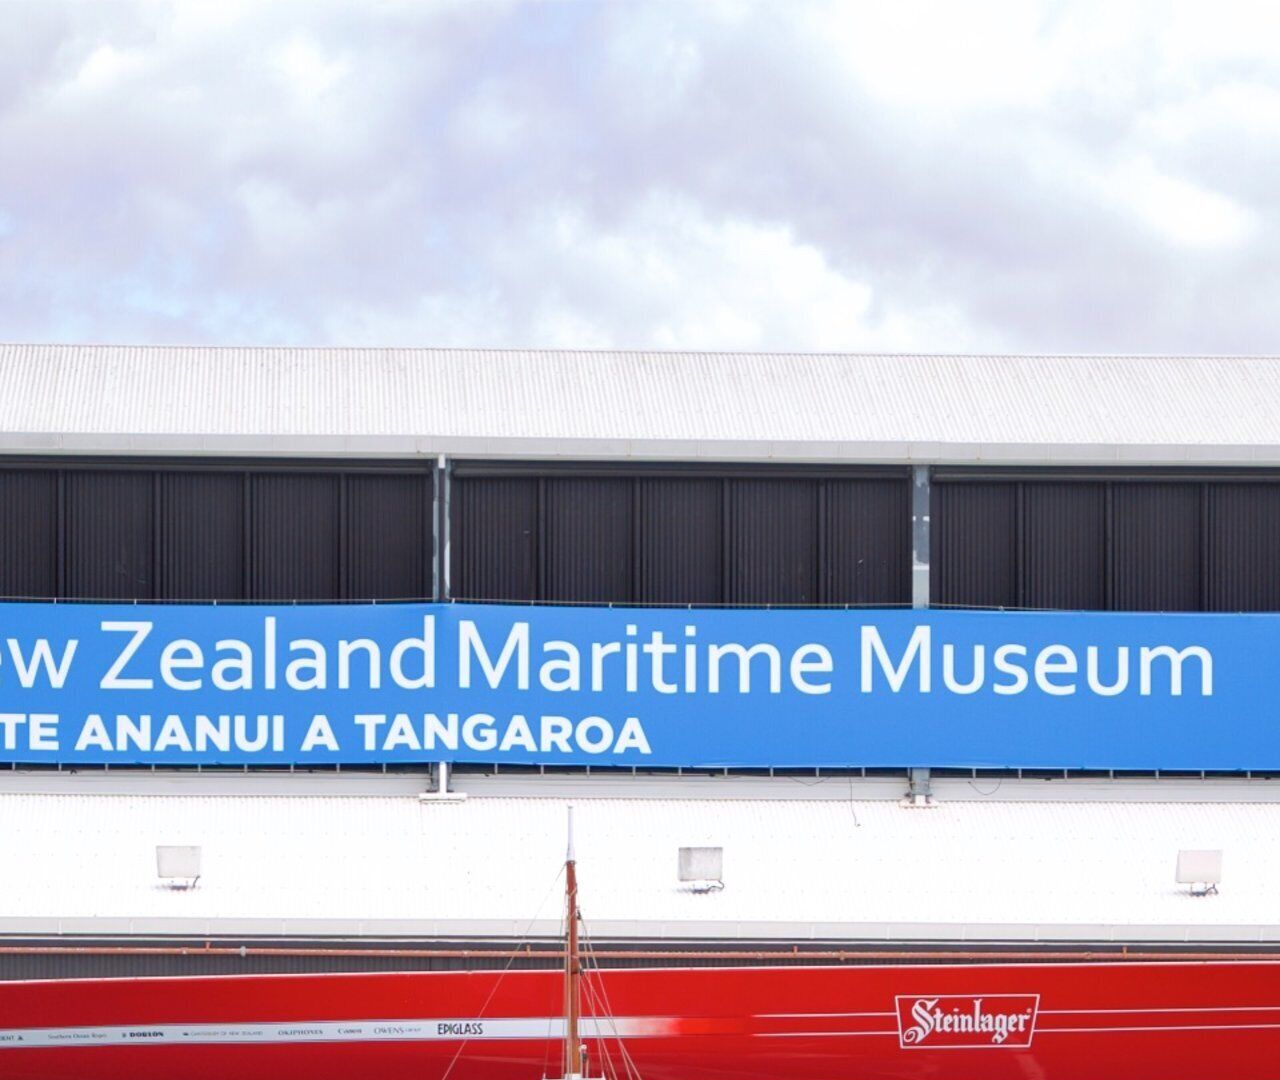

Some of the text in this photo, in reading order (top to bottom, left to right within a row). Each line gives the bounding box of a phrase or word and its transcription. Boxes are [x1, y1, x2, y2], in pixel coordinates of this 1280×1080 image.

[100, 615, 436, 691] Zealand
[458, 620, 833, 695] Maritime
[860, 625, 1213, 696] Museum
[74, 714, 284, 752] ANANUI
[300, 714, 340, 752] A
[354, 713, 652, 754] TANGAROA
[437, 1022, 483, 1035] EPIGLASS
[904, 998, 1031, 1044] Steinlager
